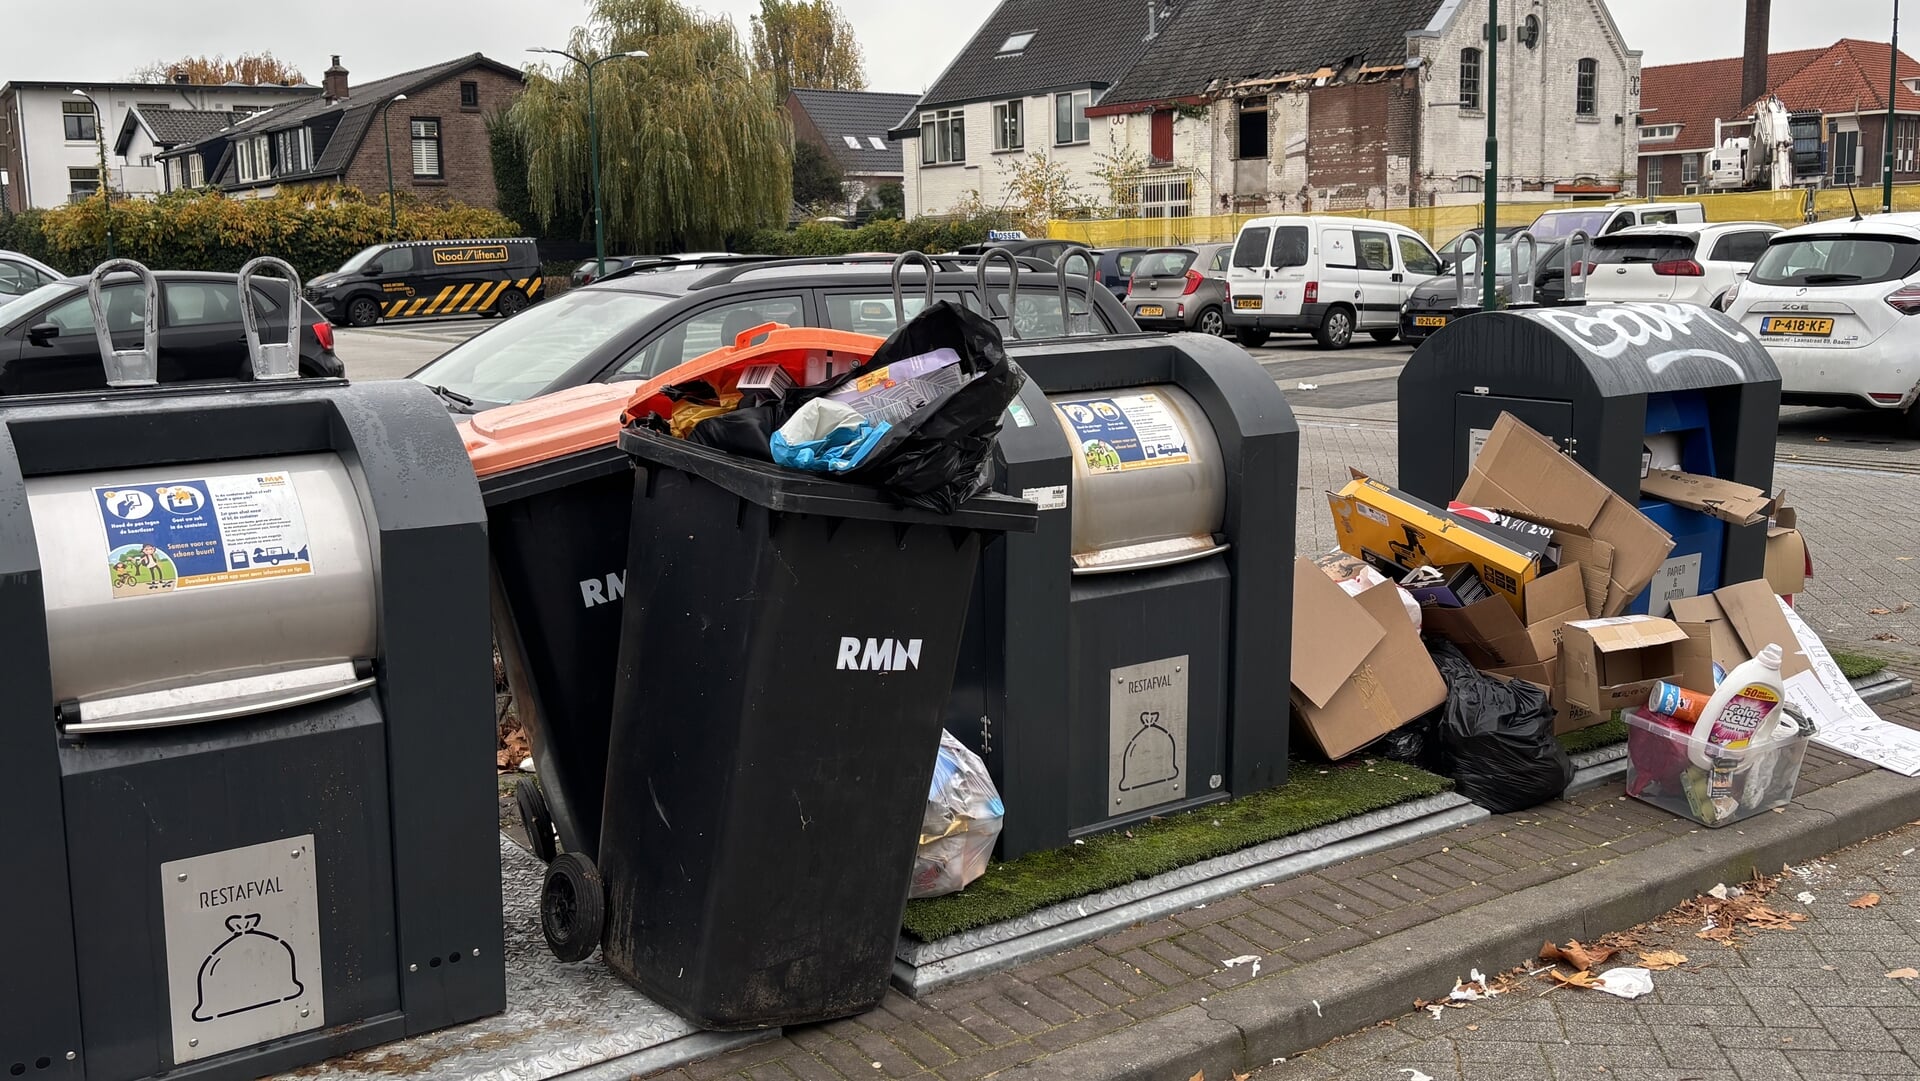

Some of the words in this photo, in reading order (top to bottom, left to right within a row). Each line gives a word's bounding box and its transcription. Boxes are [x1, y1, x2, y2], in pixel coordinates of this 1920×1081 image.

[1782, 303, 1809, 311] ZOE
[1773, 319, 1827, 332] P-418-KF
[173, 550, 194, 558] schone
[195, 547, 215, 556] buurt!
[836, 636, 923, 671] RMN
[1128, 674, 1172, 694] RESTAFVAL
[1743, 687, 1758, 697] 50
[1720, 709, 1759, 728] Reus
[1728, 703, 1761, 719] Color
[199, 876, 283, 909] RESTAFVAL
